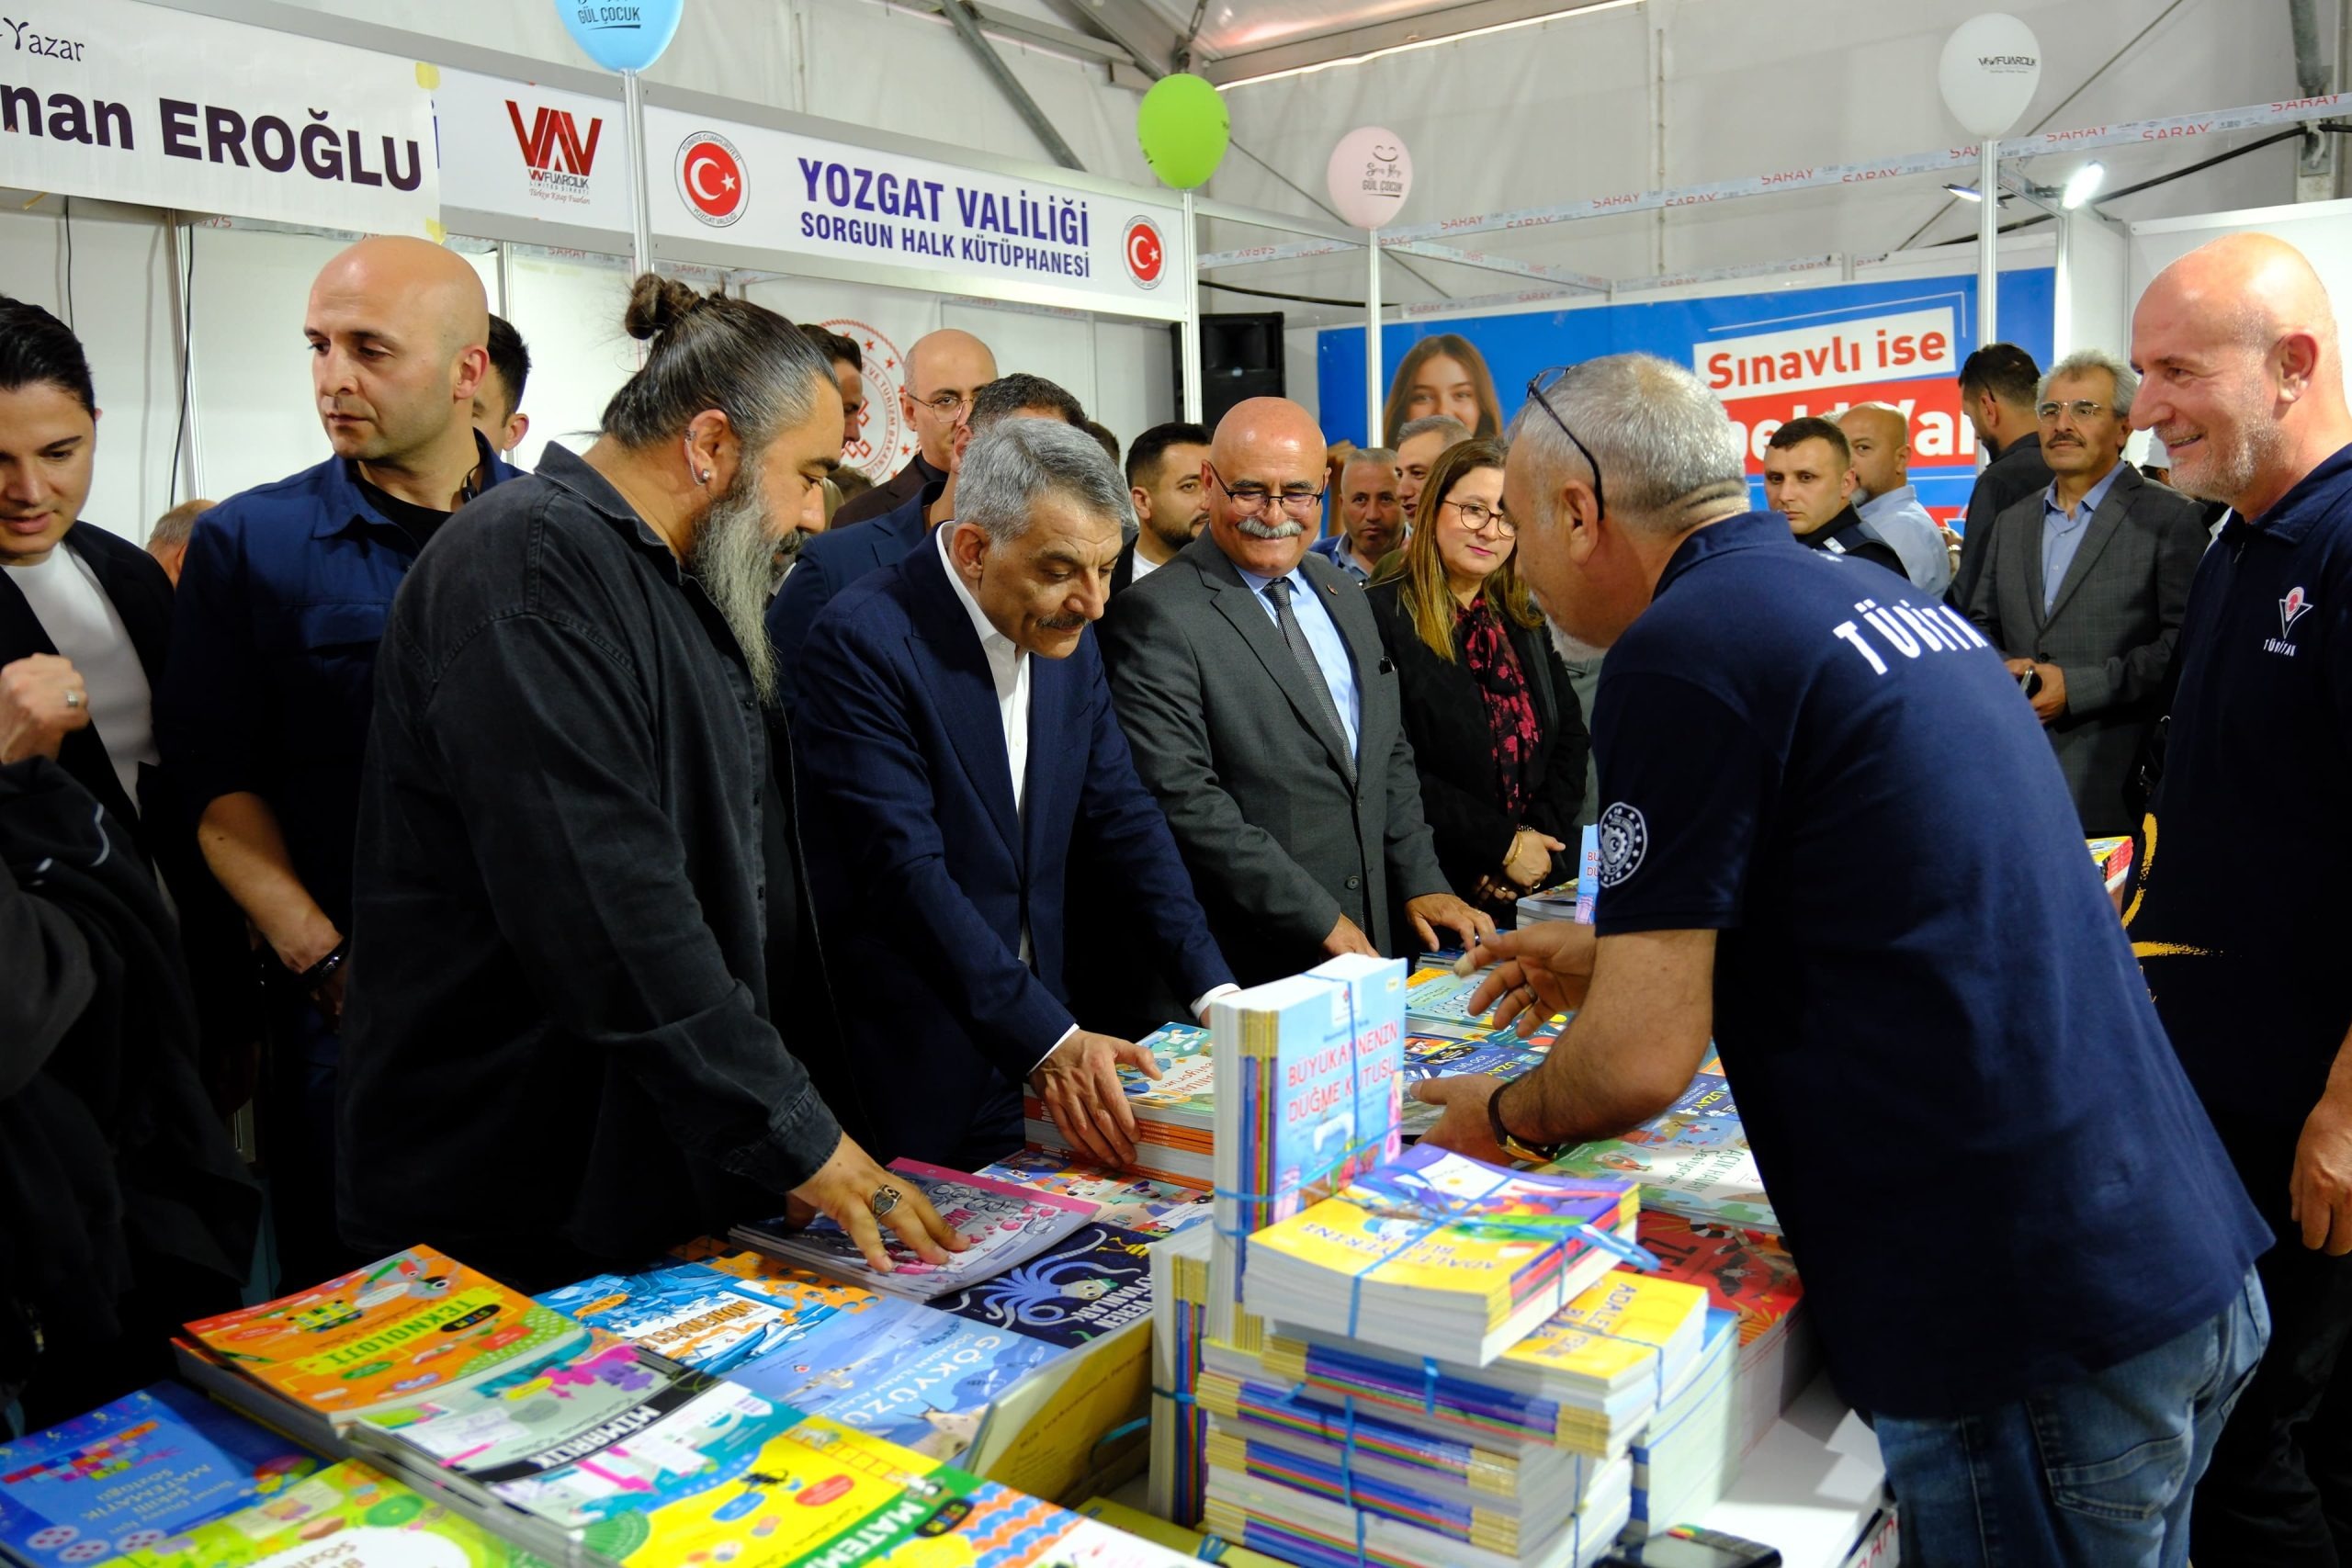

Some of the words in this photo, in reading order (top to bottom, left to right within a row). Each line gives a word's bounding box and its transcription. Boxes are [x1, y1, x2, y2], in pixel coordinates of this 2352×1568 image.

[578, 6, 599, 25] GÜL
[600, 6, 641, 25] ÇOCUK
[0, 17, 85, 62] Yazar
[0, 84, 134, 151] nan
[159, 98, 422, 192] EROĞLU
[2142, 121, 2215, 141] SARAY
[1760, 168, 1815, 186] SARAY
[797, 156, 944, 223] YOZGAT
[956, 186, 1090, 248] VALİLİĞİ
[1592, 193, 1640, 209] SARAY
[1440, 215, 1485, 230] SARAY
[800, 210, 895, 250] SORGUN
[901, 229, 956, 259] HALK
[962, 233, 1091, 278] KÜTÜPHANESİ
[1707, 335, 1861, 389] Sınavlı
[1876, 329, 1947, 368] ise
[2263, 637, 2297, 657] TÜBİTAK
[1158, 1061, 1215, 1089] eviyorum
[1484, 1060, 1522, 1077] UZAY
[1288, 1081, 1340, 1122] DÜĞME
[1692, 1089, 1728, 1110] UZAY
[1070, 1272, 1151, 1323] YVANLAR
[1092, 1299, 1153, 1328] VEREN
[630, 1299, 763, 1351] MÜHENDİSLİ
[841, 1335, 1001, 1425] GÖKYÜZÜ
[527, 1404, 662, 1470] MİMARLIK
[804, 1500, 927, 1568] MATEM
